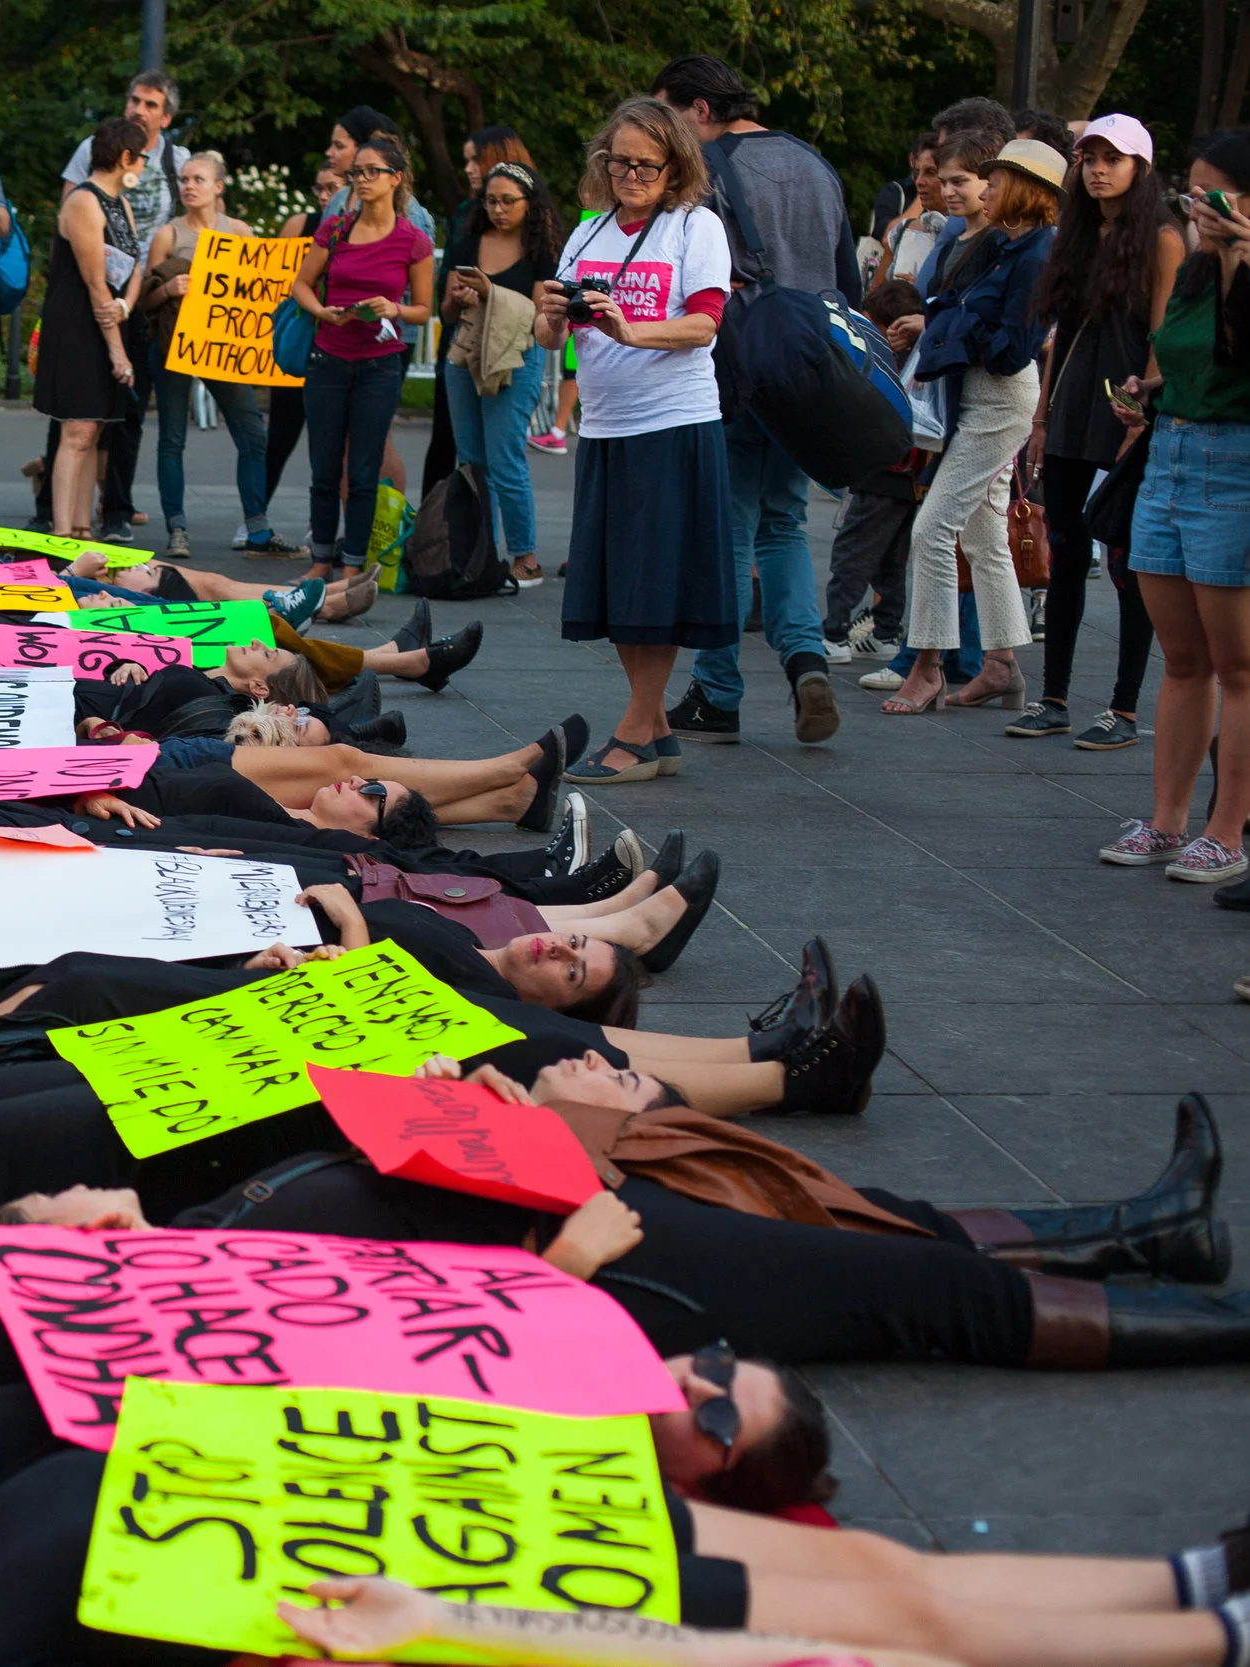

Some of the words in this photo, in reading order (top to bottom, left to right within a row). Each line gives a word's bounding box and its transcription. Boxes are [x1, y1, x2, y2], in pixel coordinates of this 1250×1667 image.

[206, 236, 232, 259] IF
[238, 242, 279, 270] MY
[281, 243, 311, 273] LIF
[204, 272, 229, 298] IS
[234, 277, 293, 303] WORTH
[609, 290, 658, 307] ENOS
[616, 271, 661, 291] UNA
[207, 304, 274, 339] PROD
[633, 308, 659, 317] NYC
[79, 631, 120, 671] NG
[132, 634, 181, 665] OP
[50, 757, 132, 788] NOT
[249, 968, 367, 1051] DERECHO
[333, 953, 467, 1041] TENEMOS
[180, 1006, 300, 1096] CAMINAR
[76, 1021, 148, 1057] SIN
[118, 1055, 223, 1135] MIEDO
[103, 1235, 208, 1271] LO
[216, 1238, 370, 1328] CADO
[450, 1266, 578, 1314] AL
[146, 1278, 292, 1389] HACE
[118, 1439, 262, 1581] STOP
[277, 1406, 403, 1610] OLENCE
[540, 1451, 655, 1611] OMEN
